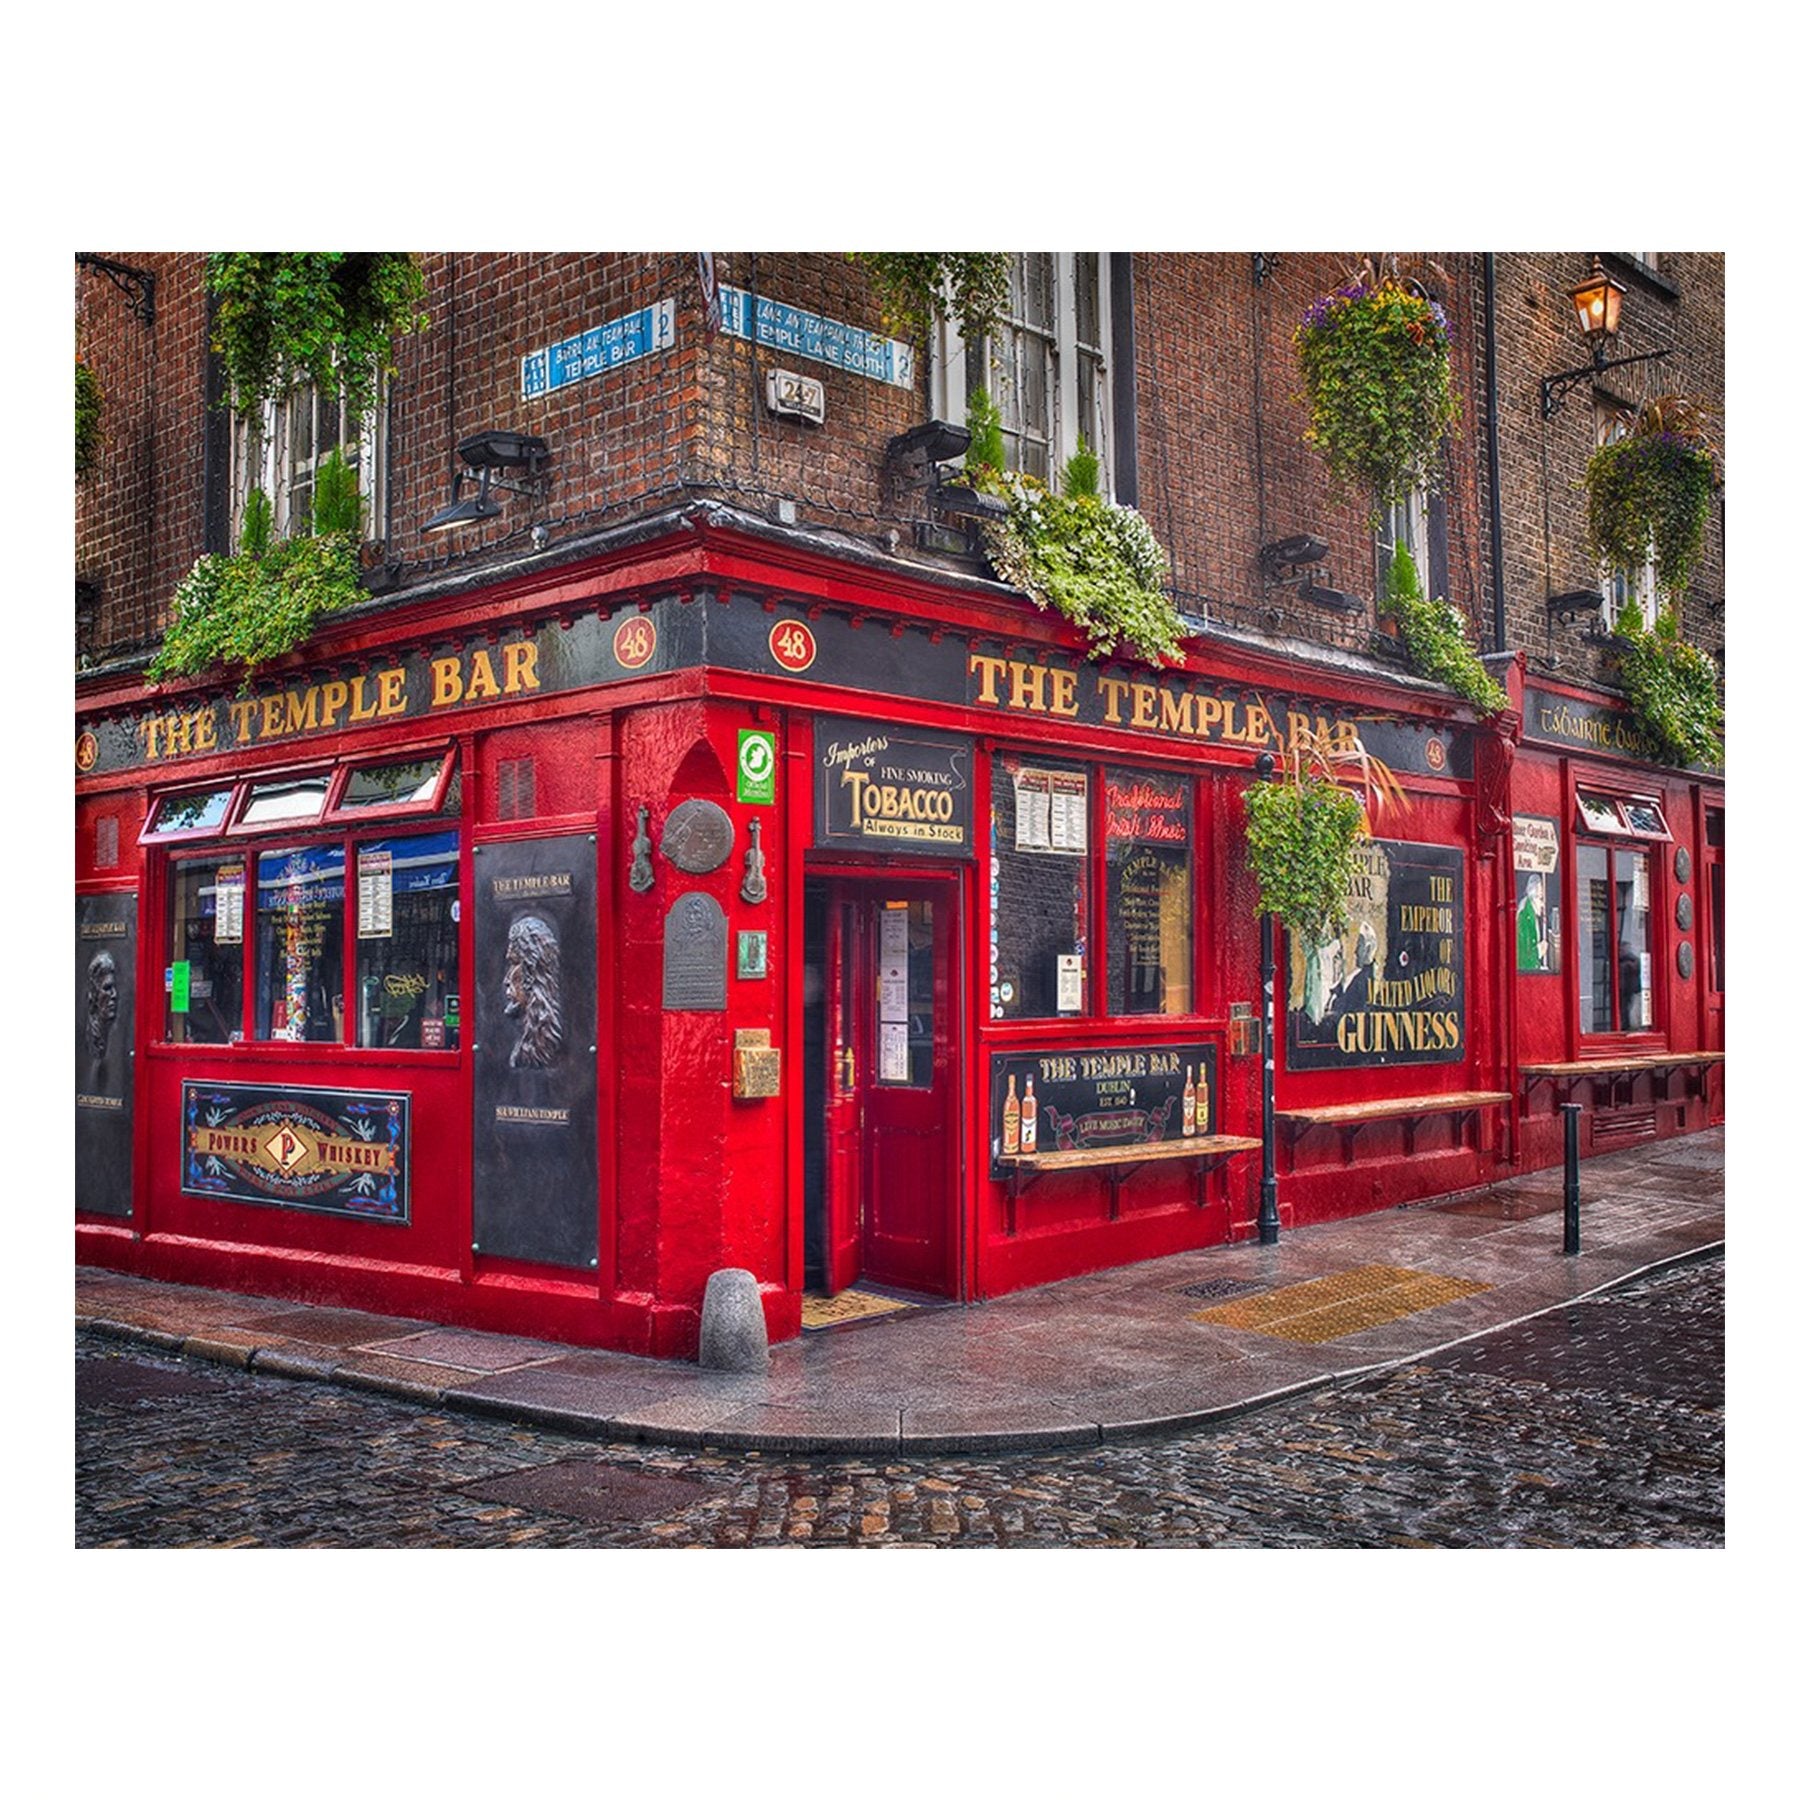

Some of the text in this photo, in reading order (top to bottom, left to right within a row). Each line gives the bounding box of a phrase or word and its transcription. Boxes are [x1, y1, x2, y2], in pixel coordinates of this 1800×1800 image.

[658, 313, 670, 338] 2
[565, 340, 636, 379] TEMPLE BAR
[757, 323, 885, 378] TEMPLE LANE SOUTH
[899, 355, 910, 380] 2
[620, 626, 649, 660] 48
[777, 627, 807, 660] 48
[139, 640, 541, 760] THE TEMPLE BAR
[970, 654, 1360, 756] THE TEMPLE BAR
[823, 735, 890, 770] Importers
[880, 765, 953, 787] FINE SMOKING
[840, 770, 954, 828] TOBACCO
[864, 818, 963, 841] Always in Stock
[1429, 876, 1454, 903] THE
[1400, 904, 1454, 934] EMPEROR
[1439, 939, 1454, 964] OF
[1337, 1011, 1461, 1054] GUINNESS
[1038, 1051, 1182, 1082] THE TEMPLE BAR
[1096, 1079, 1131, 1094] DUBLIN
[208, 1132, 382, 1167] POWERS P WHISKEY
